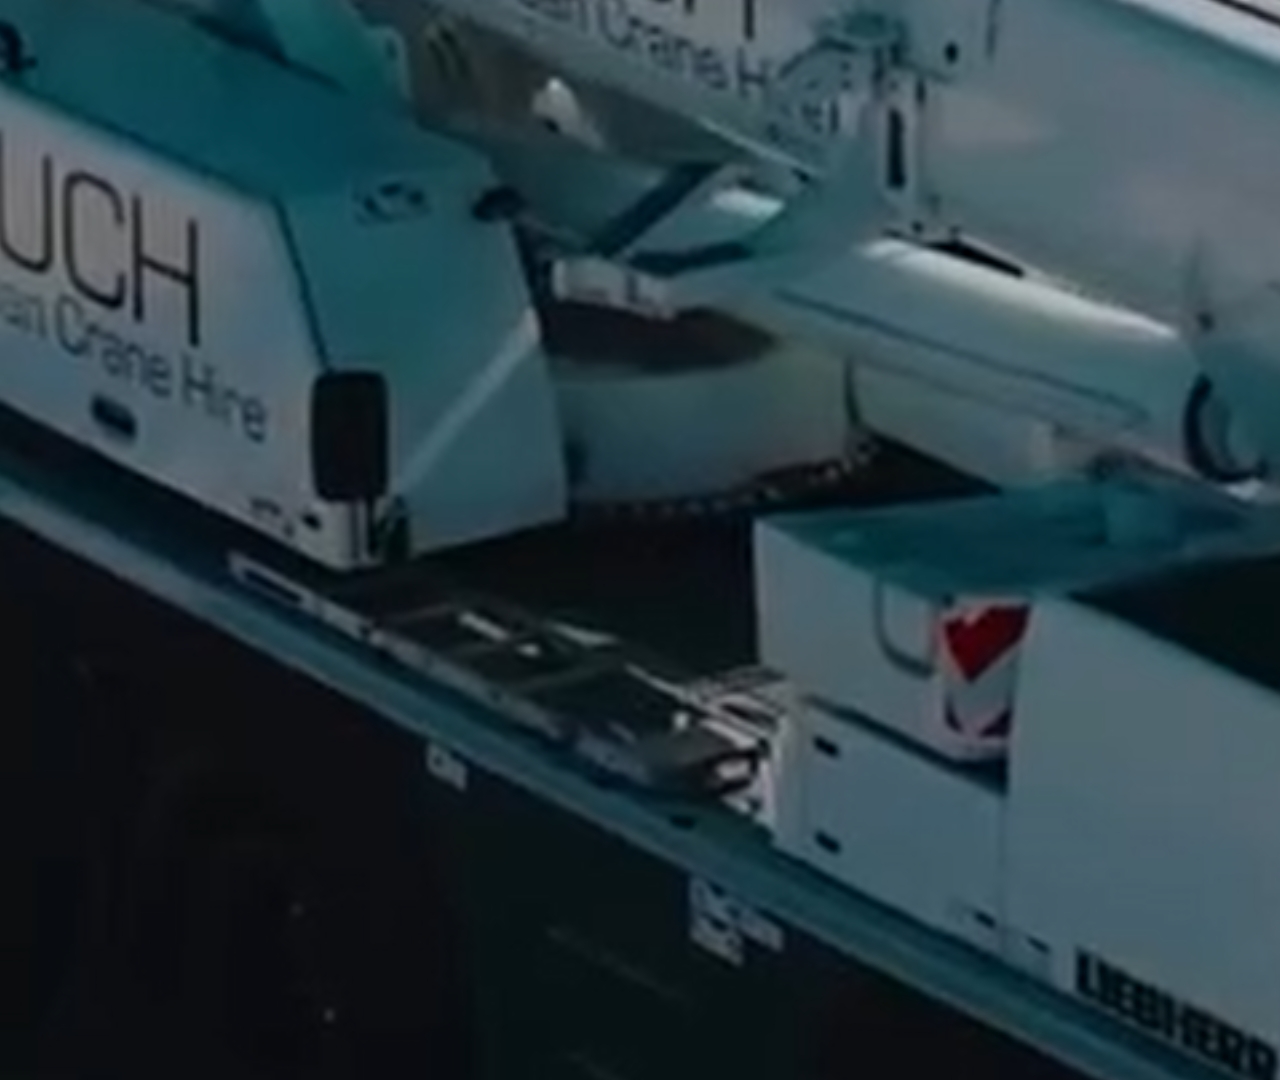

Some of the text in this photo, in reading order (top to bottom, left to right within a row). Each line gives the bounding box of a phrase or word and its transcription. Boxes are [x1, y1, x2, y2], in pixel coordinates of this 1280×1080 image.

[0, 126, 200, 347] UCH
[54, 294, 172, 398] Crane
[181, 352, 267, 444] Hire
